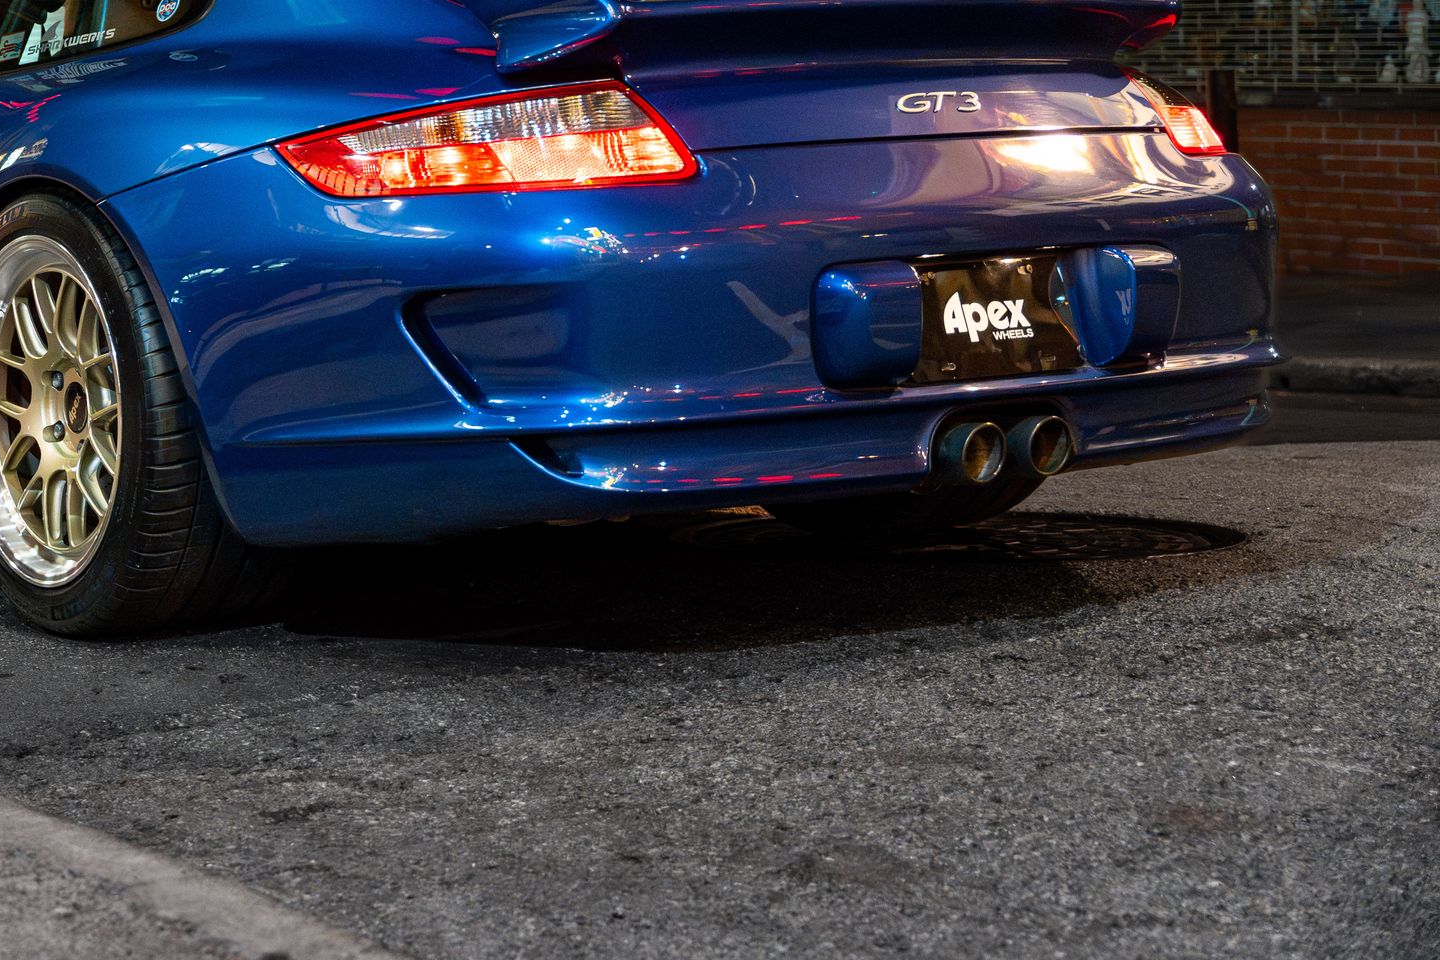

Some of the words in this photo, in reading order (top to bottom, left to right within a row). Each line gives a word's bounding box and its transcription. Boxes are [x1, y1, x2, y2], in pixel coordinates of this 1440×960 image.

[896, 91, 982, 113] GT3
[943, 291, 1031, 343] Apex
[992, 328, 1034, 340] WHEELS
